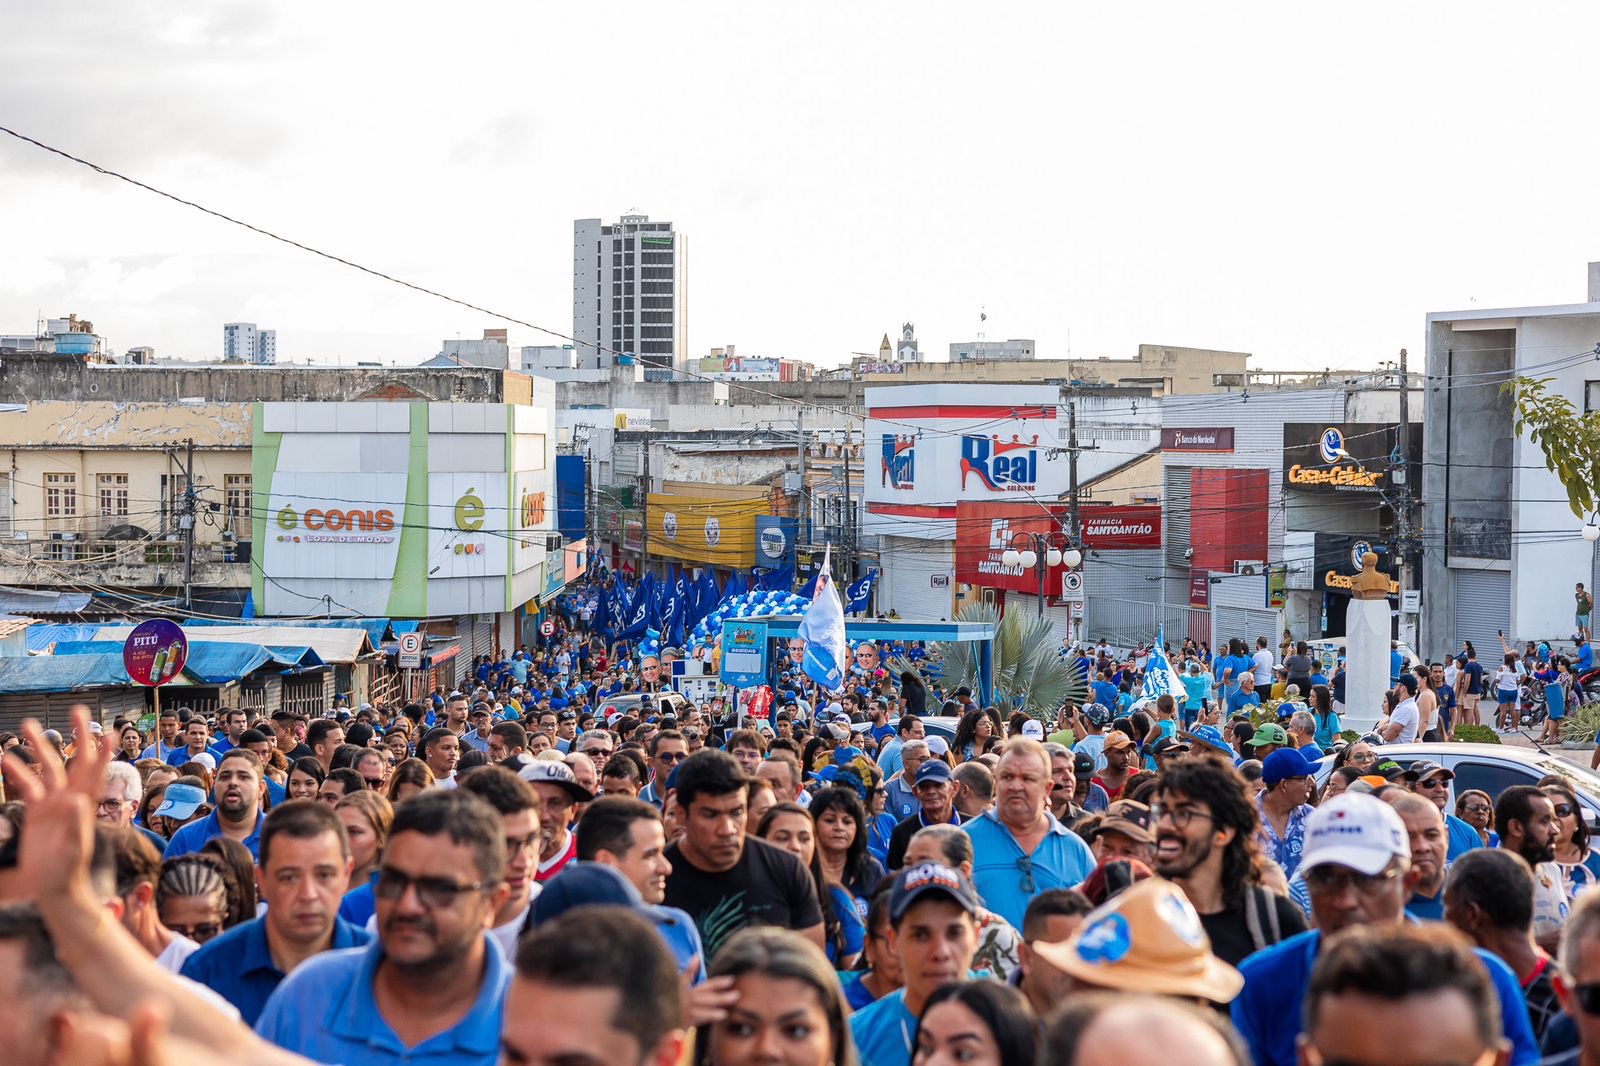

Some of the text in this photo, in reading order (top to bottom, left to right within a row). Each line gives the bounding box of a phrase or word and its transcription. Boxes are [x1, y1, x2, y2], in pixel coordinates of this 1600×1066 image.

[961, 433, 1037, 492] Real
[1289, 464, 1319, 484] Casa
[1330, 465, 1384, 487] Celular
[307, 535, 334, 543] LOJA
[357, 536, 389, 544] MODA
[133, 633, 159, 647] PITÚ
[407, 638, 413, 649] E
